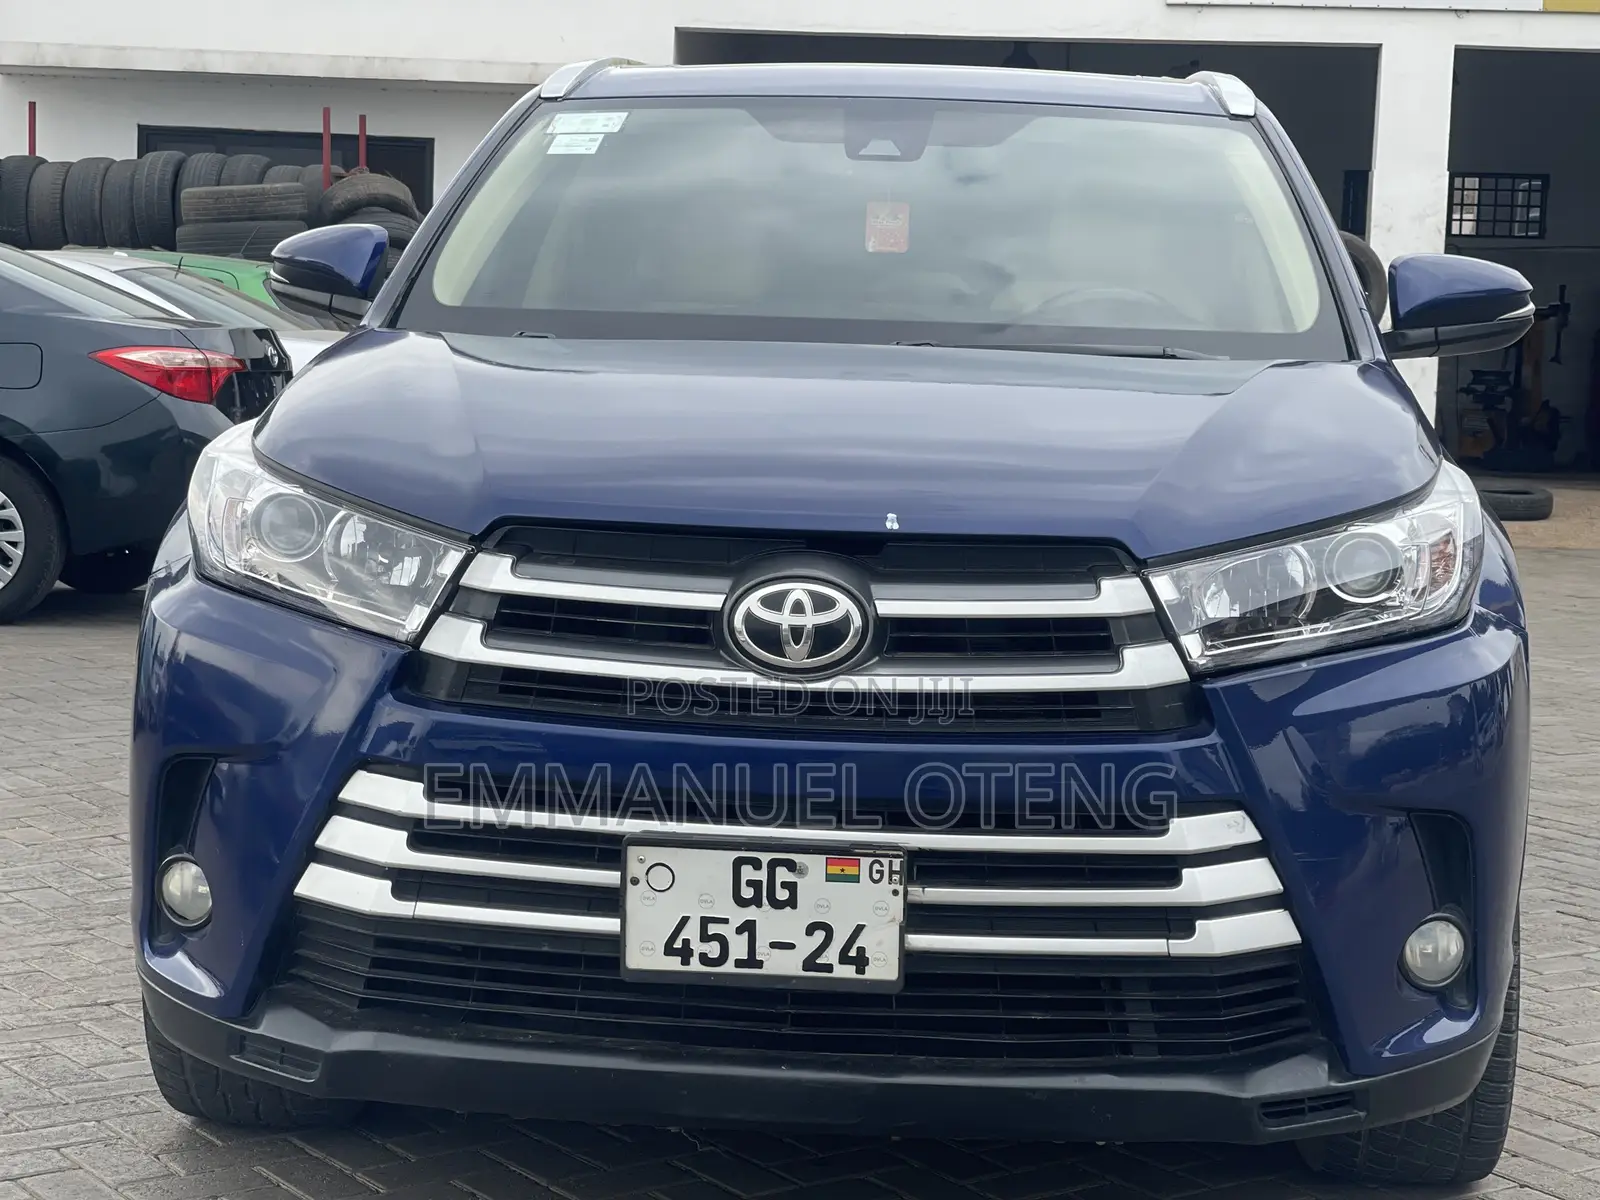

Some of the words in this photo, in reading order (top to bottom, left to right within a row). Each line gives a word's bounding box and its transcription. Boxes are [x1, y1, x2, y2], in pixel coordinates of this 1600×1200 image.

[732, 855, 798, 910] GG
[869, 859, 904, 886] GH
[663, 915, 870, 975] 451-24
